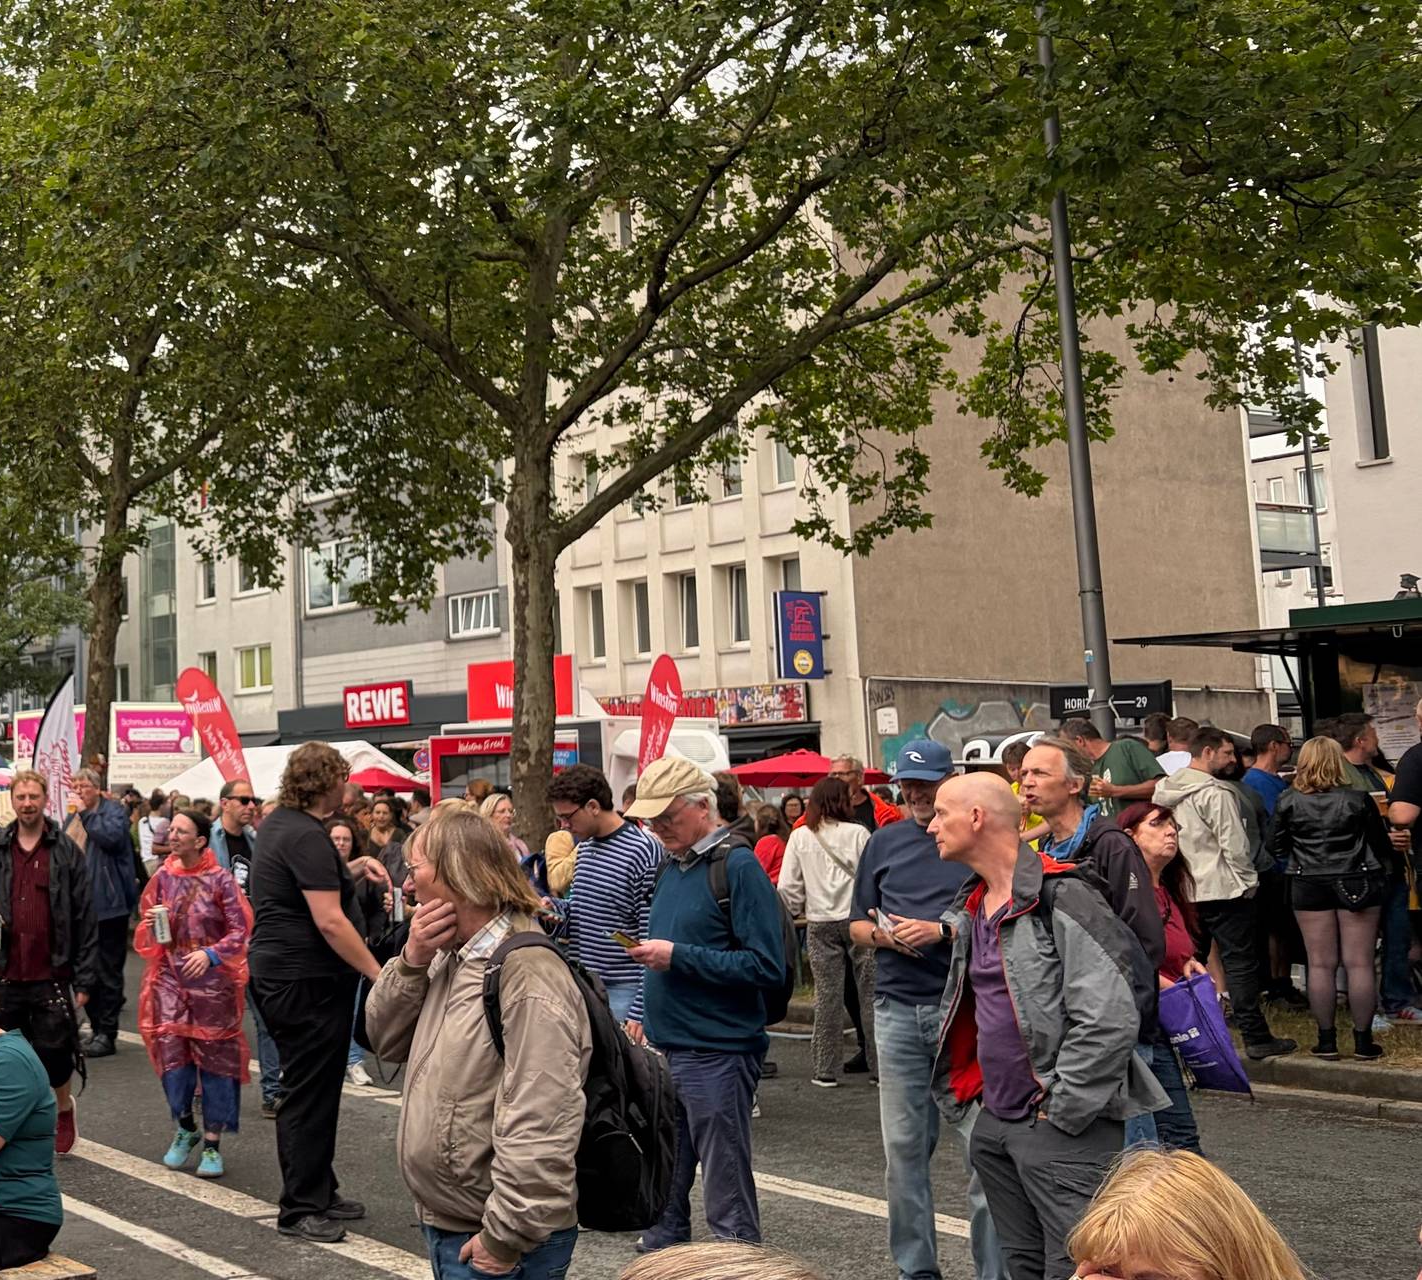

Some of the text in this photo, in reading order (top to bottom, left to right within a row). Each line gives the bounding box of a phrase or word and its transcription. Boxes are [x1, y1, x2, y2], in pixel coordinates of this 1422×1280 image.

[346, 686, 406, 723] REWE
[650, 681, 678, 716] Winston
[1135, 696, 1147, 708] 29
